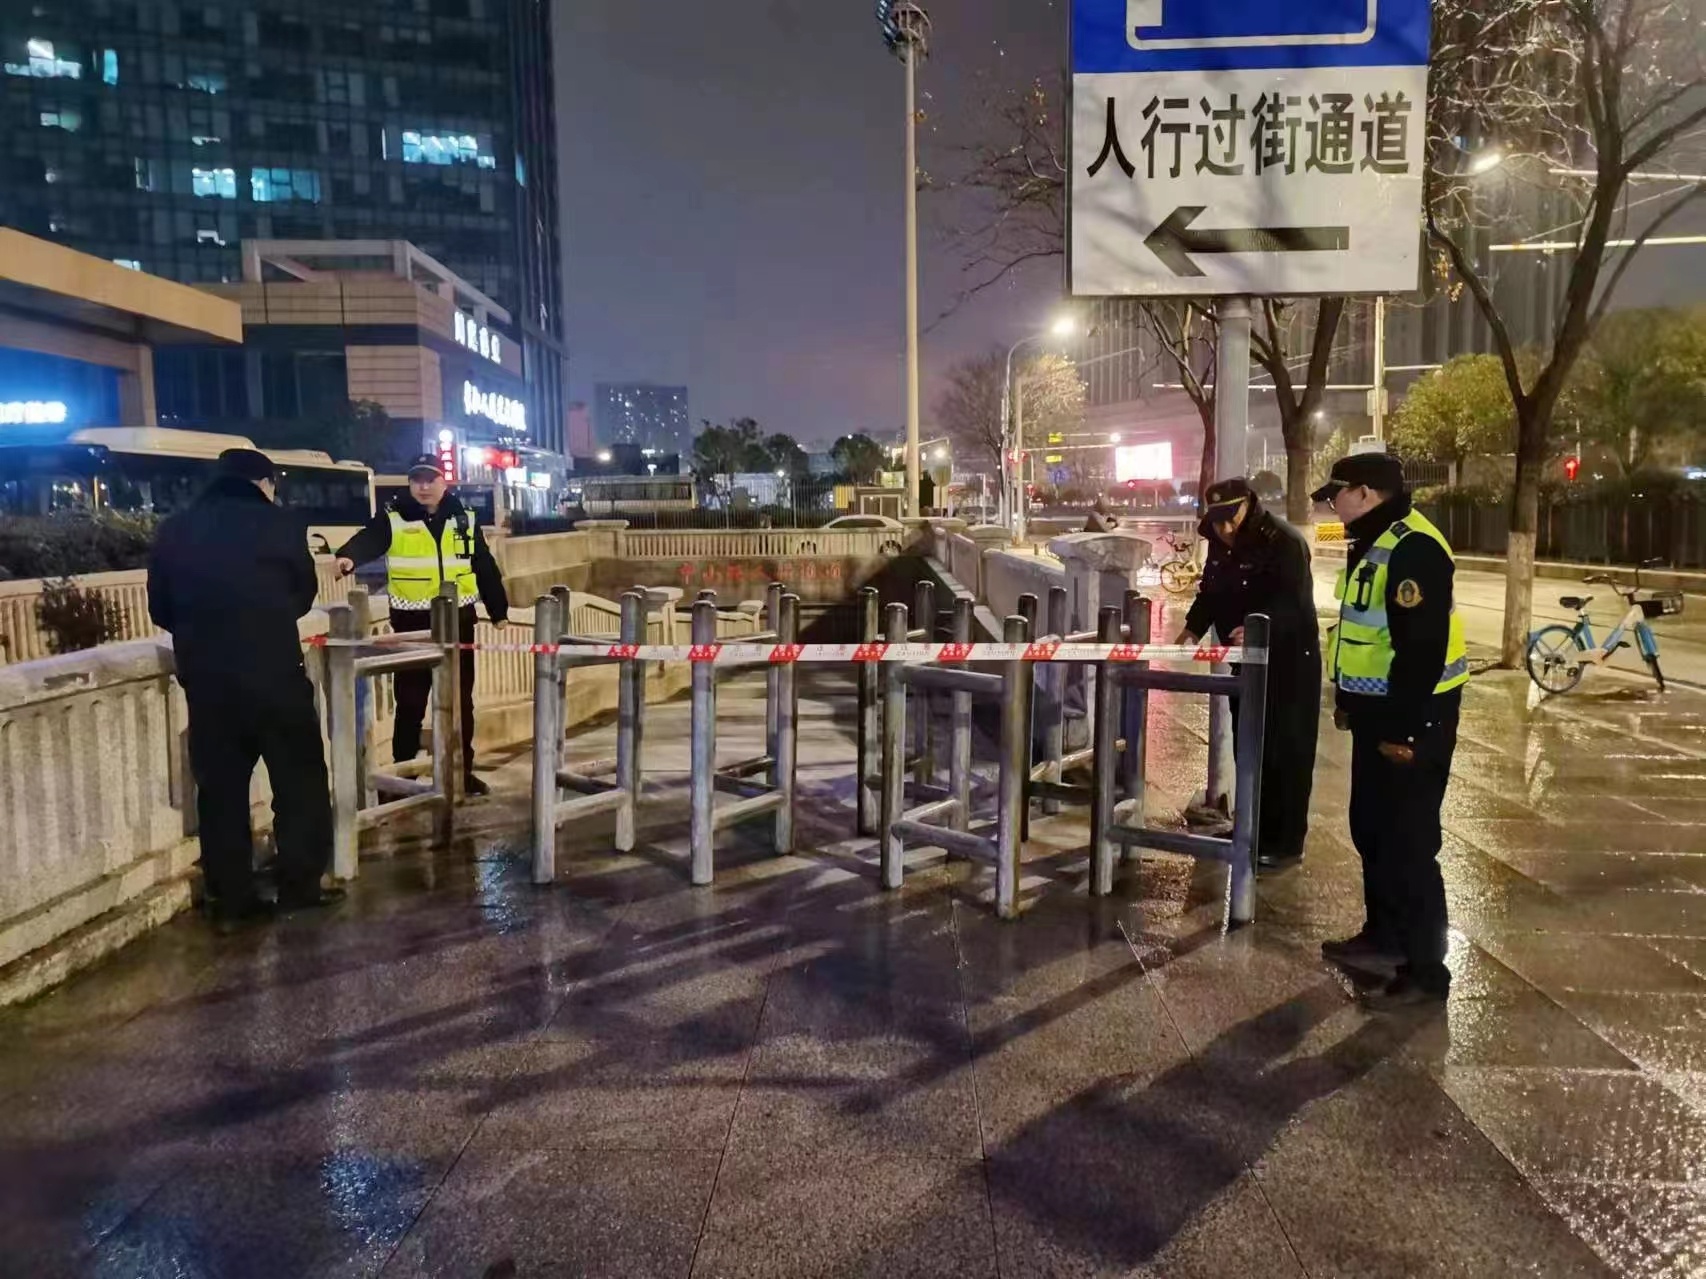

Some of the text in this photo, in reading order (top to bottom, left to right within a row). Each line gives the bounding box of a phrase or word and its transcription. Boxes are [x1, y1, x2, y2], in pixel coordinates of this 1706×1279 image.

[1086, 90, 1412, 179] 人行过街通道
